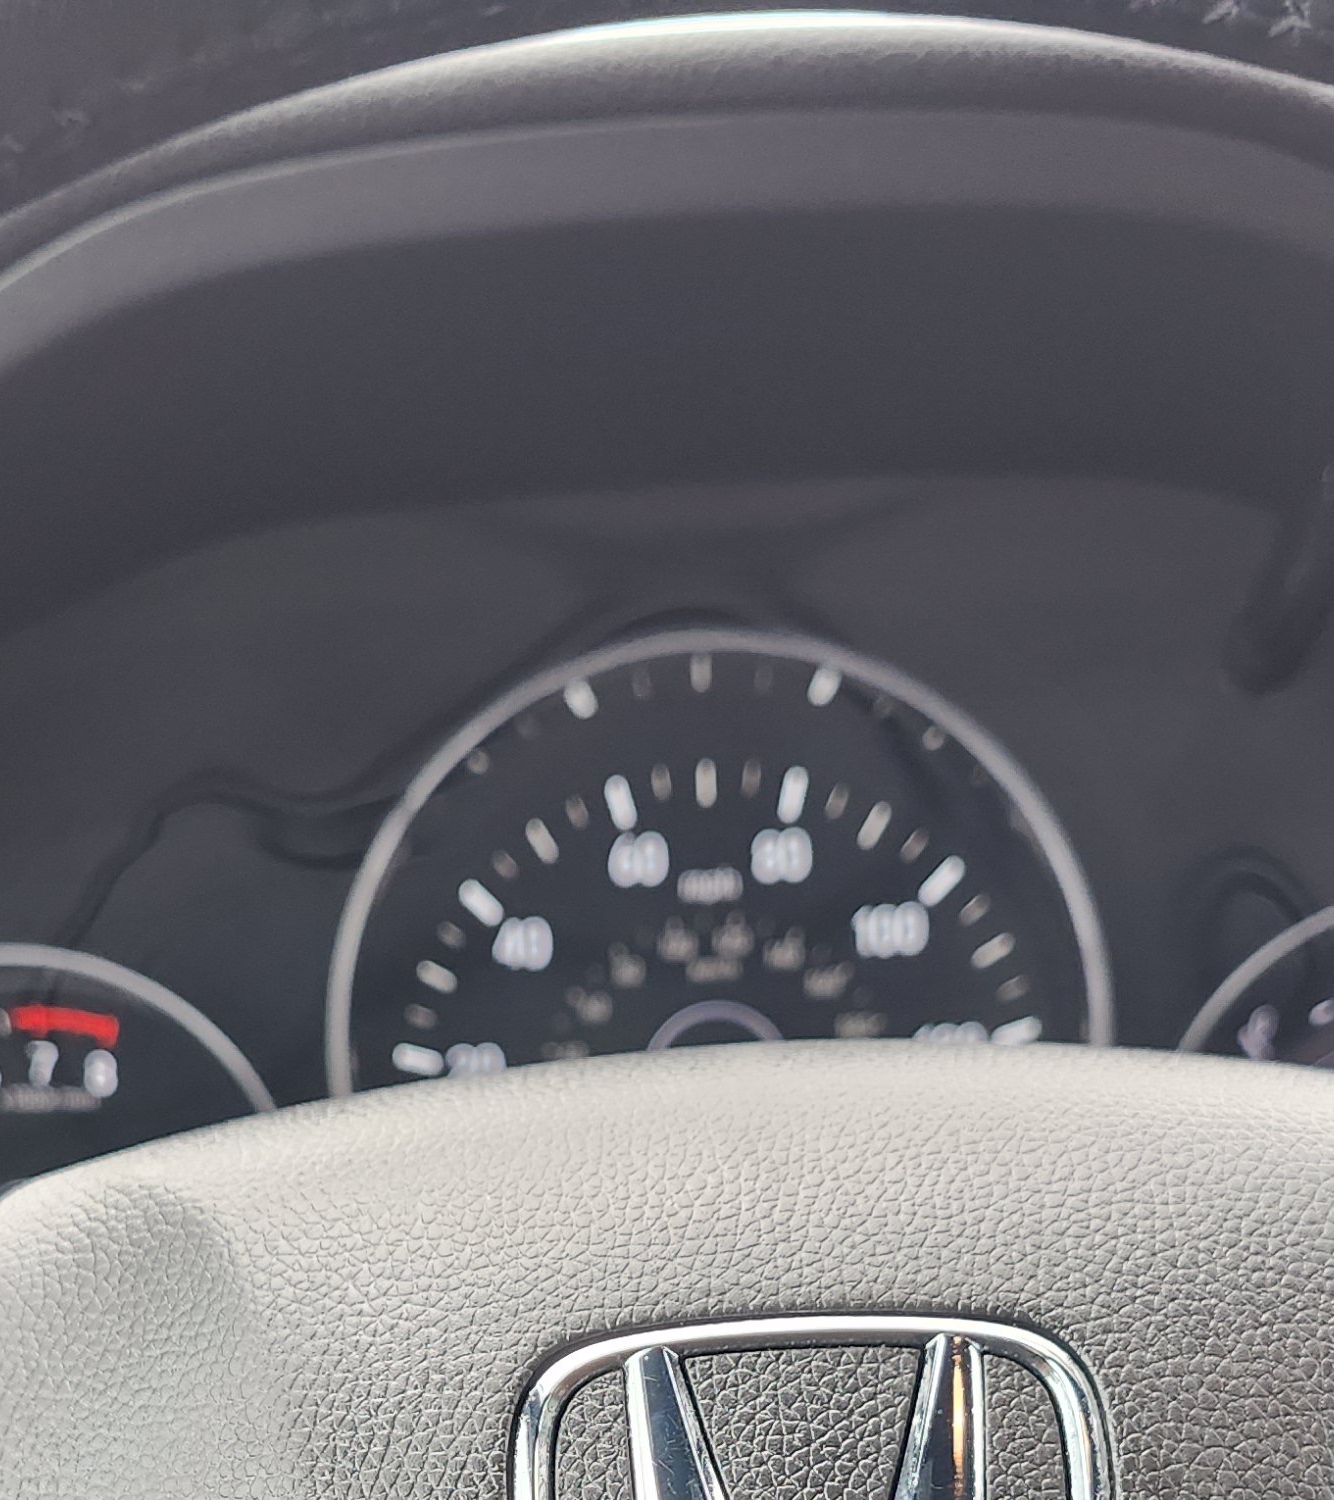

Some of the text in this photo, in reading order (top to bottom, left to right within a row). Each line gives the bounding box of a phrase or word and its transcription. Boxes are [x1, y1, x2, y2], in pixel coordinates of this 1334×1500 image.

[607, 831, 670, 888] 60
[852, 901, 930, 959] 100
[26, 1040, 59, 1088] 7
